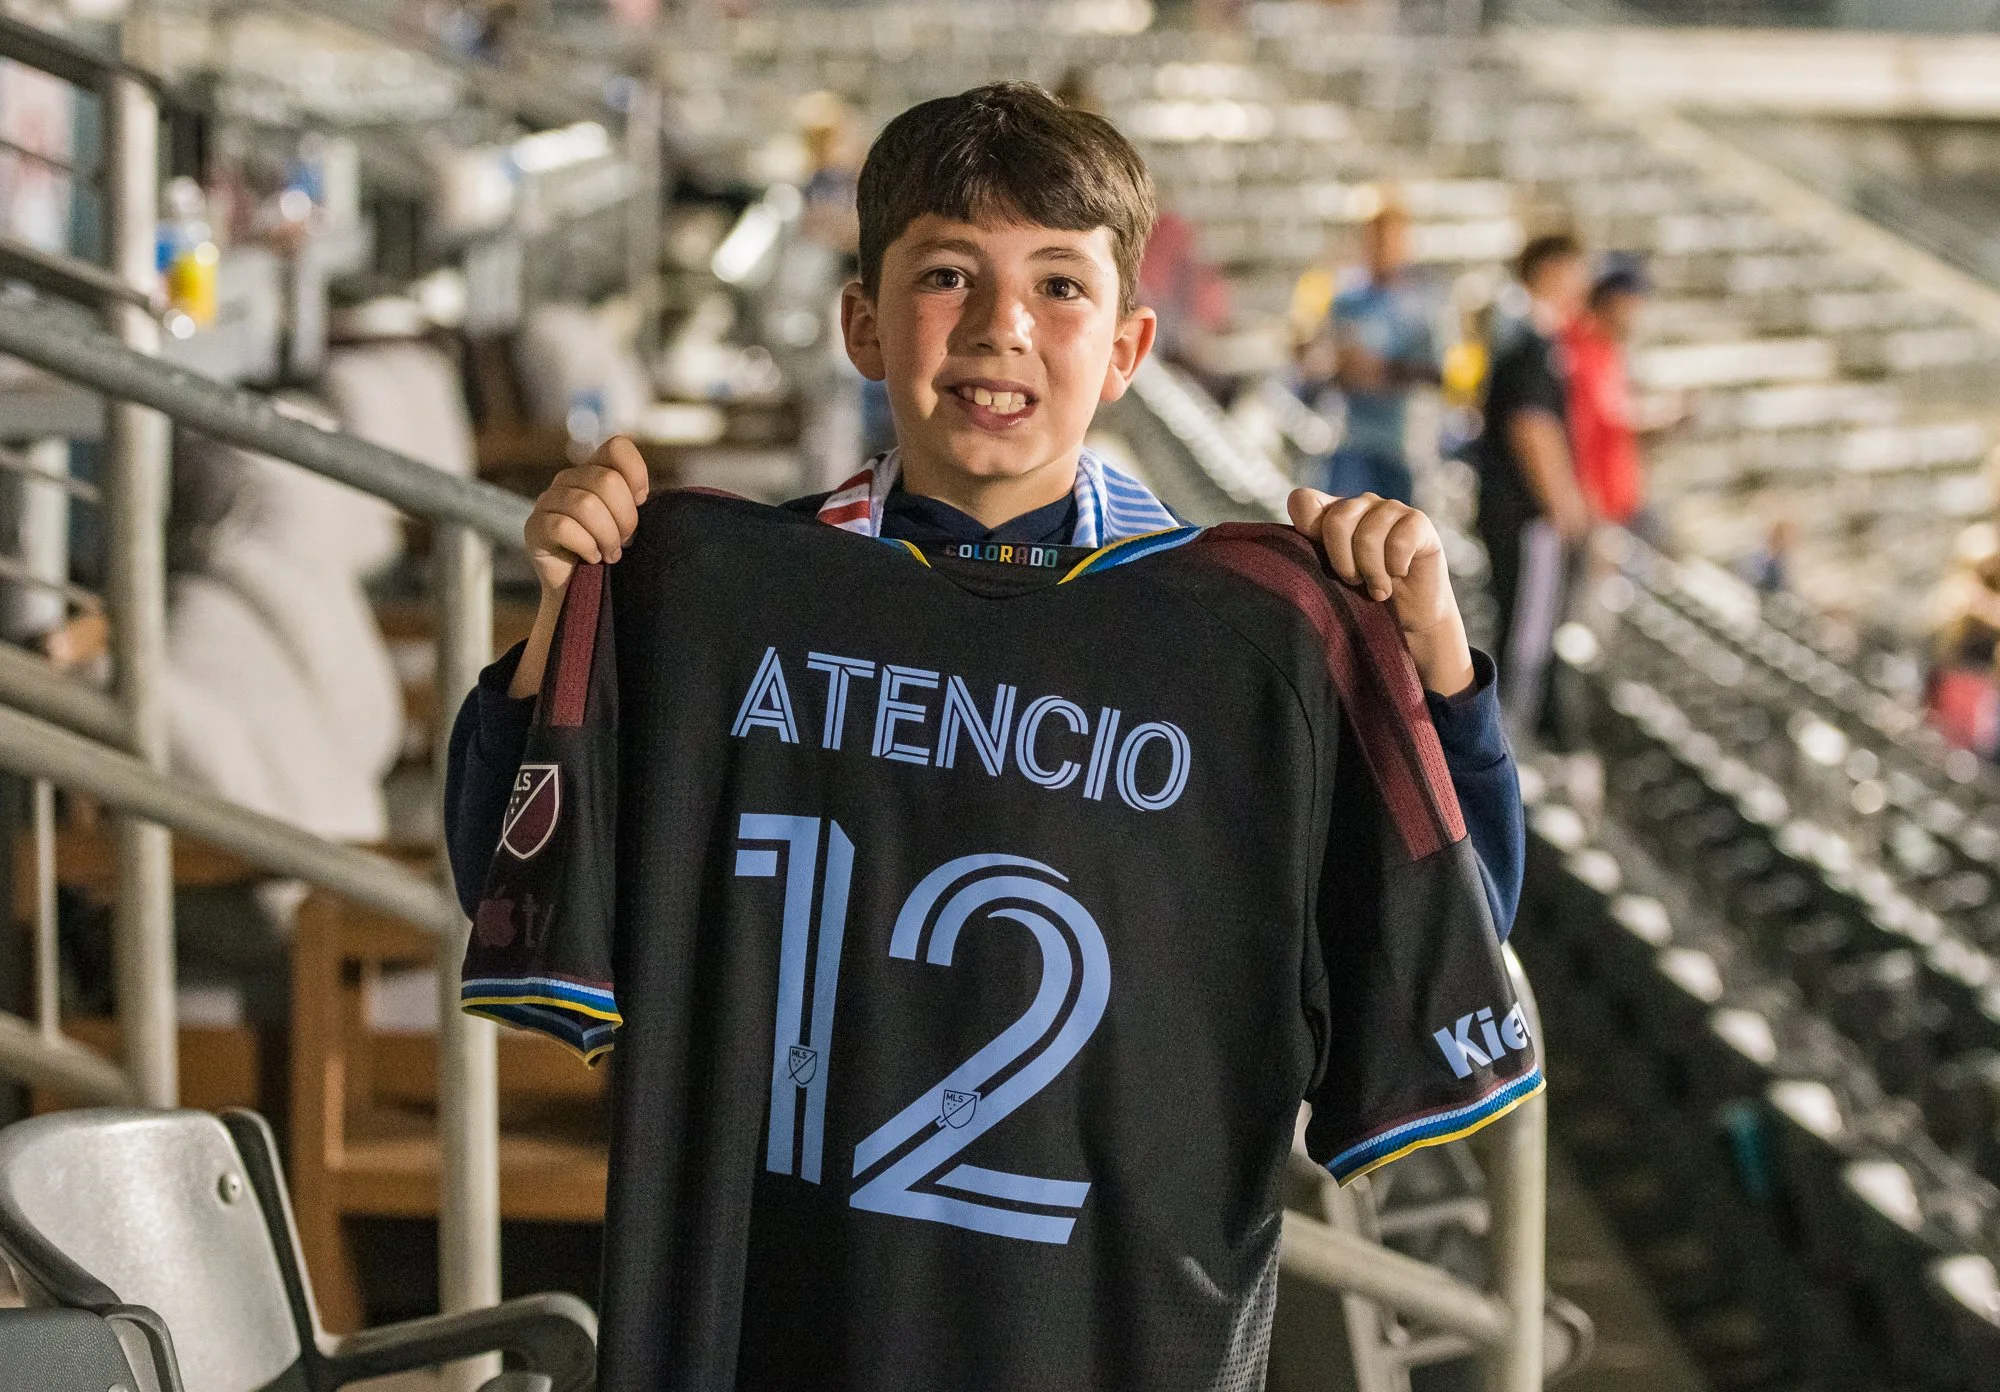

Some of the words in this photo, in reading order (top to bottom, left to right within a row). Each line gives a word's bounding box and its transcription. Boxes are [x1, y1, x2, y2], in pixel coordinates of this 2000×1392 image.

[944, 544, 1058, 568] COLORADO
[731, 646, 1192, 812] ATENCIO
[513, 772, 531, 791] LS
[735, 813, 1111, 1244] 12
[791, 1049, 807, 1060] MLS
[946, 1092, 964, 1103] MLS
